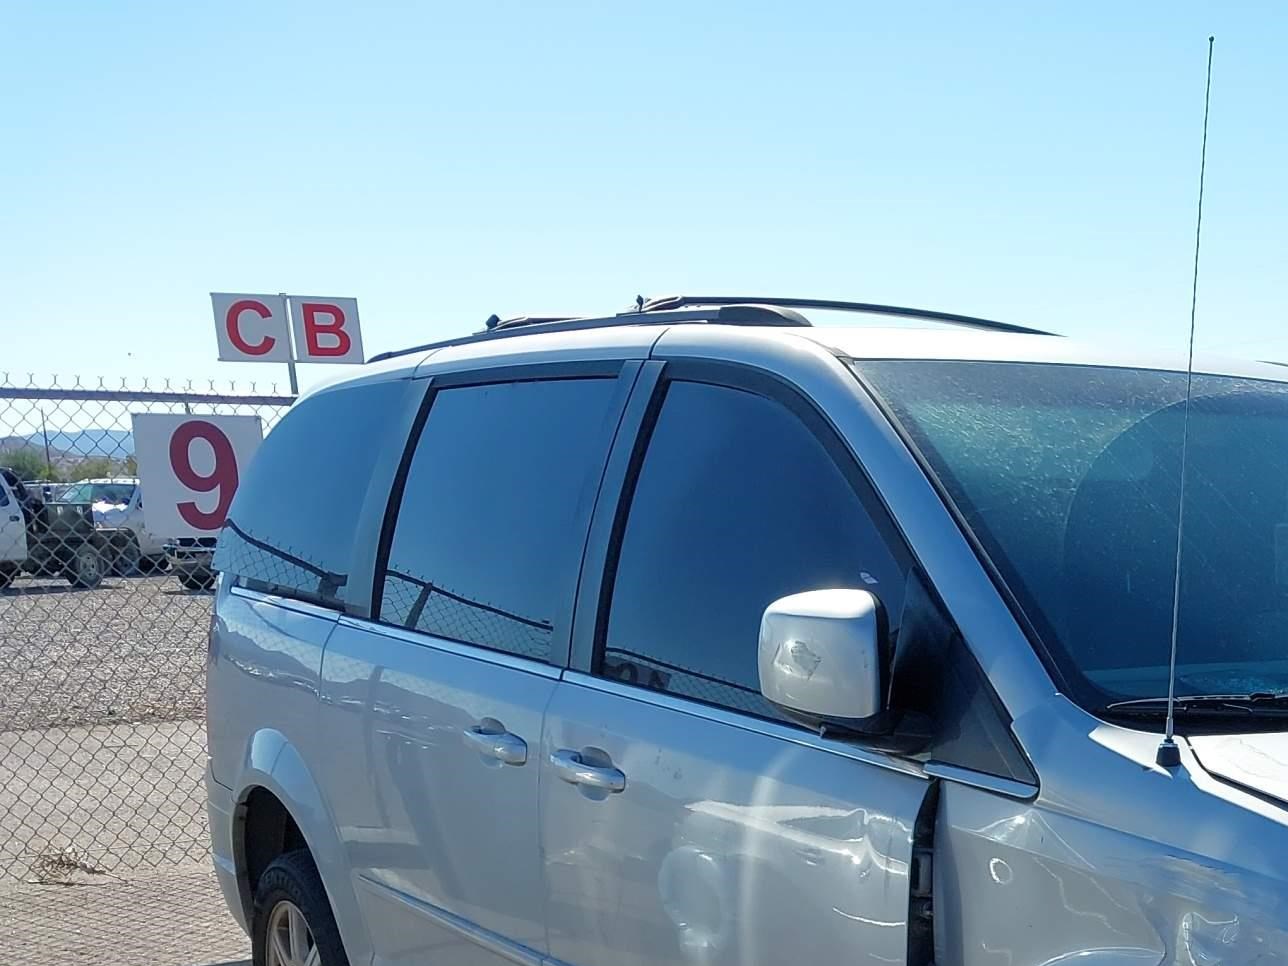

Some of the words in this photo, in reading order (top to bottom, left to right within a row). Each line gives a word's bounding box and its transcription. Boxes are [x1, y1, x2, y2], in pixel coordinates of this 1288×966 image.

[226, 300, 276, 355] C
[302, 303, 351, 356] B
[169, 420, 239, 530] 9
